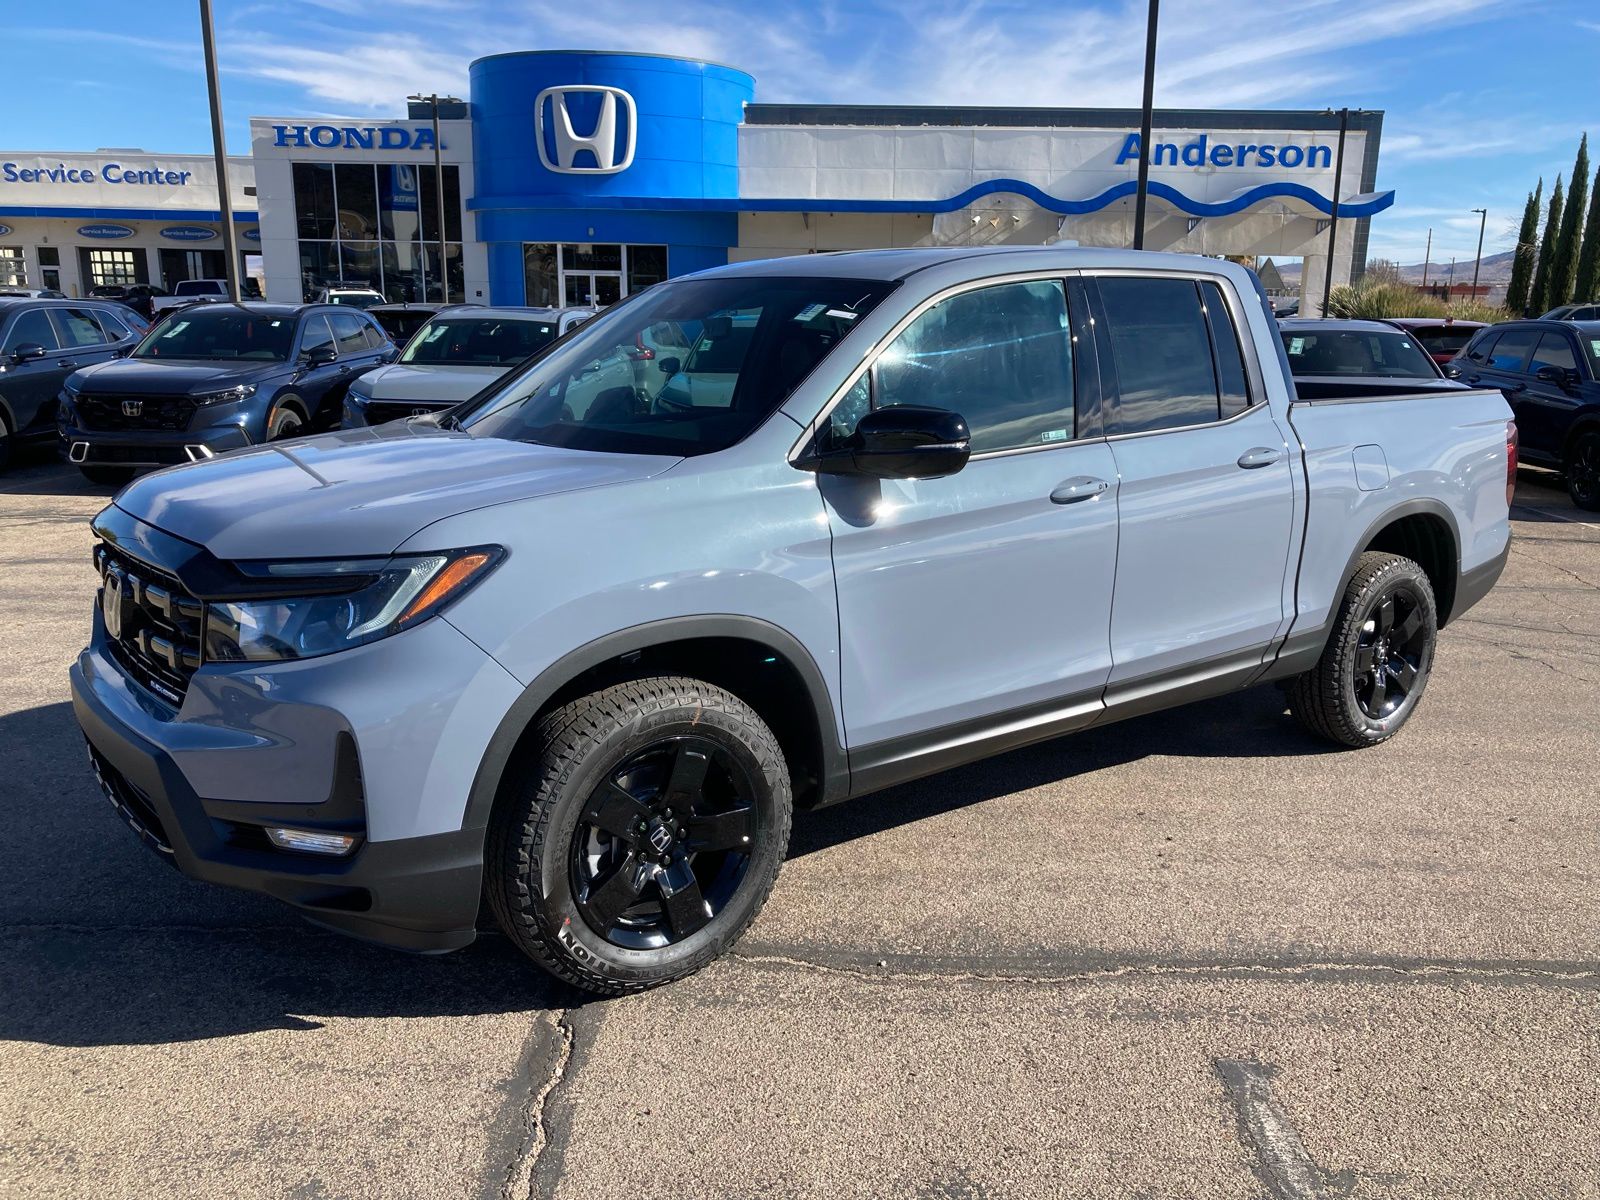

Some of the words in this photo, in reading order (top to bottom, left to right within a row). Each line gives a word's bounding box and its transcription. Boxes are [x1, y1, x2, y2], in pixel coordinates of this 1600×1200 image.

[272, 125, 447, 150] HONDA
[1115, 132, 1332, 168] Anderson
[2, 162, 95, 183] Service
[102, 163, 191, 186] Center
